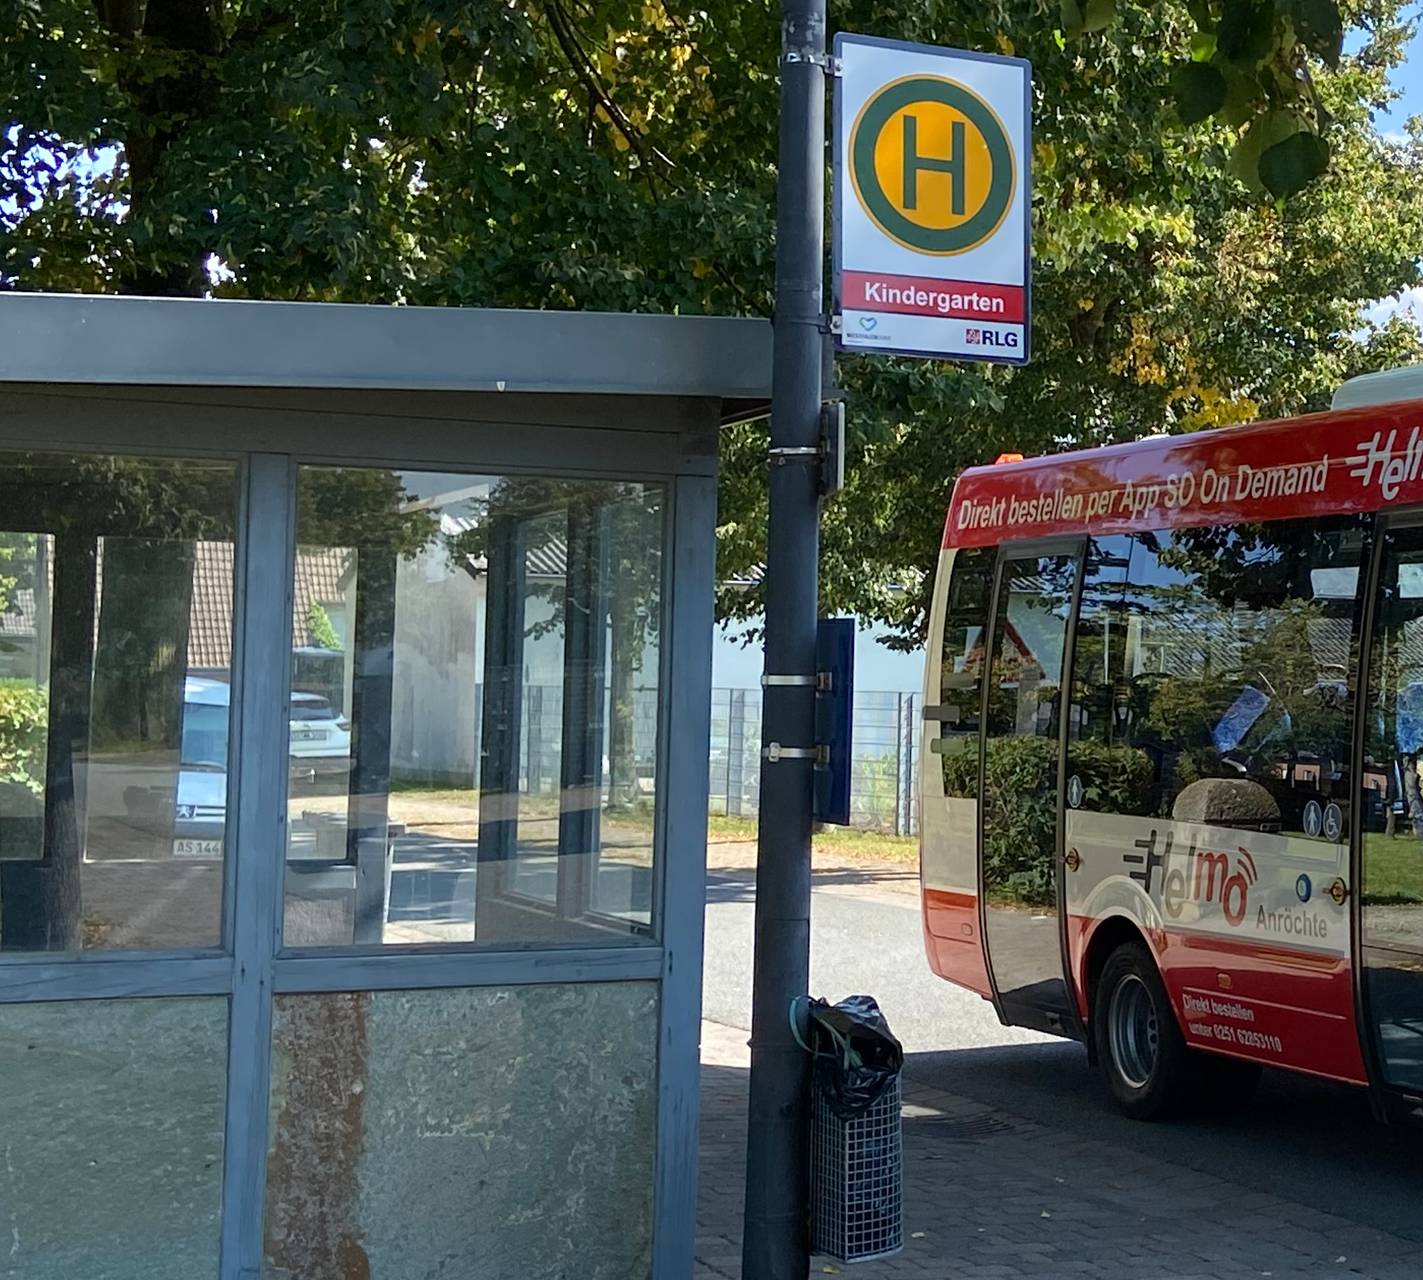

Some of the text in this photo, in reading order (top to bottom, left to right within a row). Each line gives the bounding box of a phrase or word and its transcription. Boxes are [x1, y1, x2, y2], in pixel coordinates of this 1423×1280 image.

[903, 114, 966, 216] H
[864, 281, 1005, 313] Kindergarten
[982, 330, 1019, 348] RLG
[957, 453, 1329, 531] Direkt bestellen per App SO On Demand
[1255, 903, 1329, 939] Anröchte
[1182, 992, 1255, 1022] Direkt bestellen
